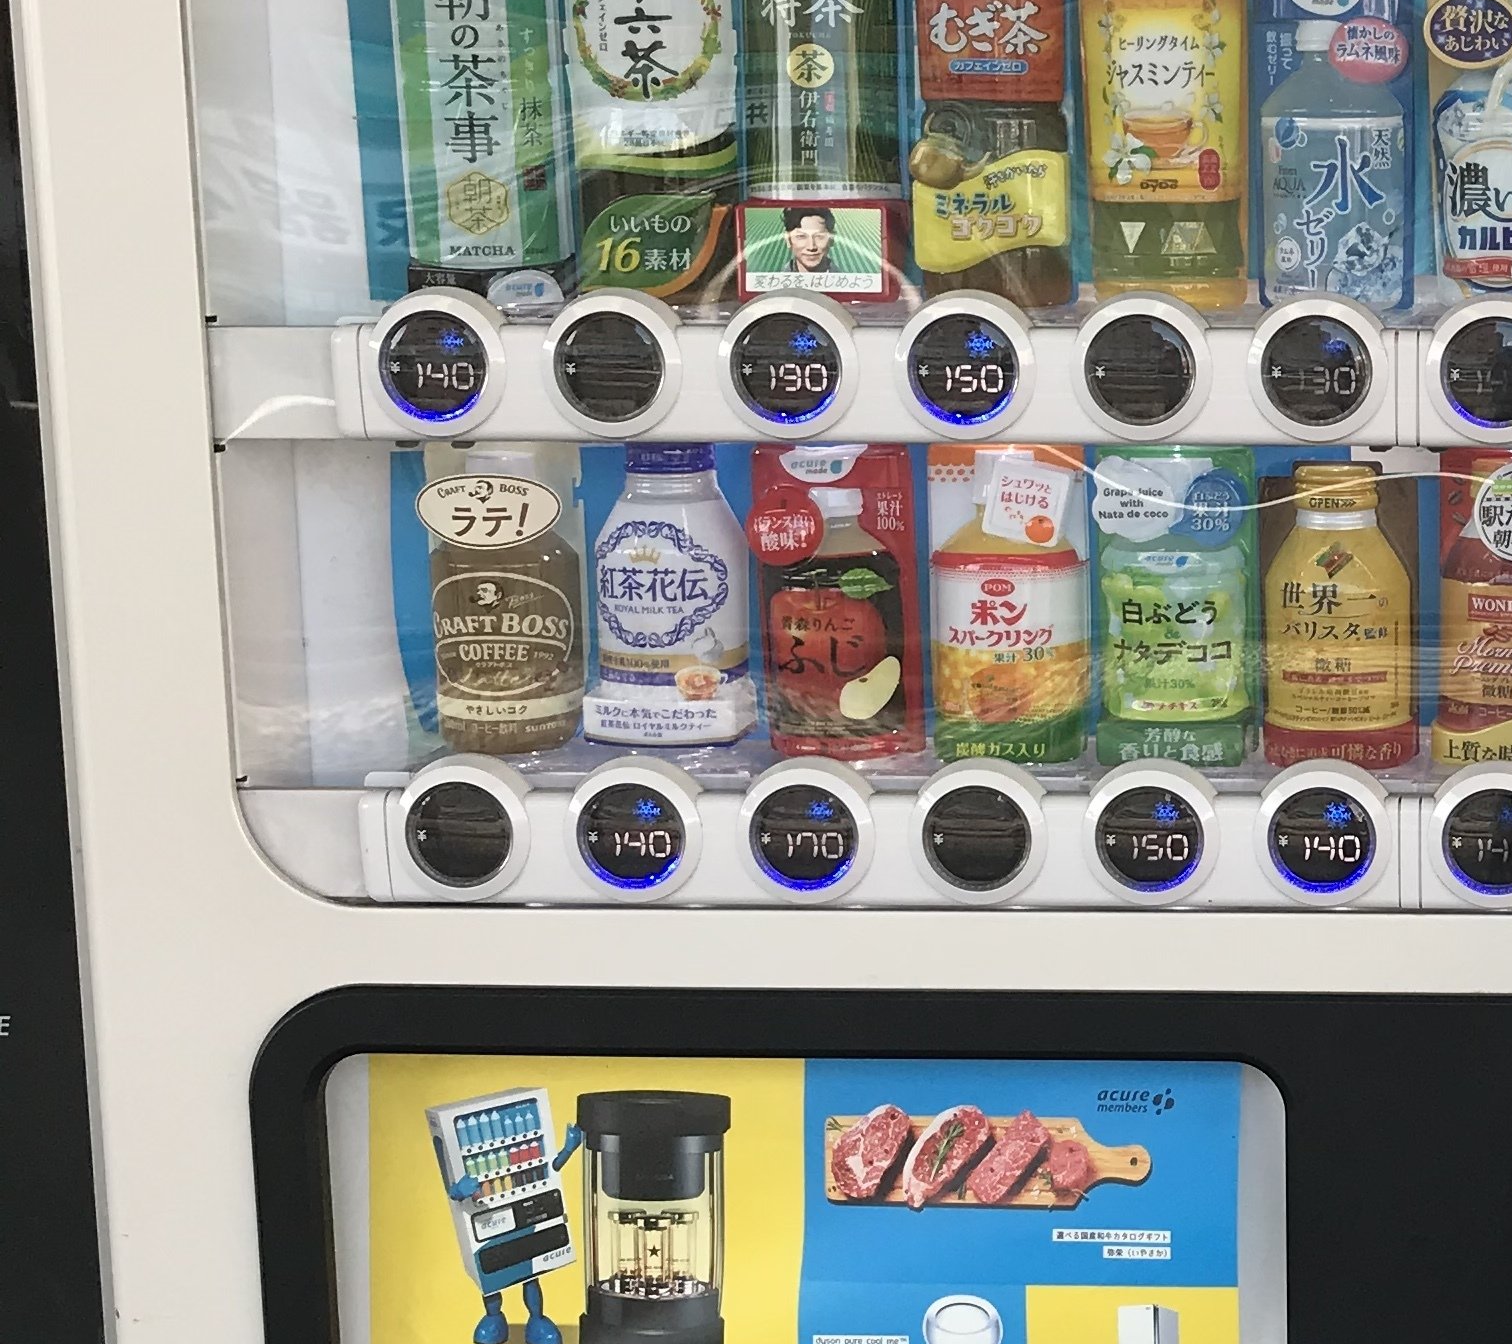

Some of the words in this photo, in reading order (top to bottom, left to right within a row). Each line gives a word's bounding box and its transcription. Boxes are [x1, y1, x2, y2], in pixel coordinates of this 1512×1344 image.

[928, 0, 1050, 56] むぎ茶
[792, 49, 829, 83] 茶
[607, 212, 693, 236] いいもの
[595, 235, 693, 273] 16素材
[415, 361, 476, 391] 140
[945, 364, 1006, 395] 150
[451, 502, 530, 538] ラテ!
[1098, 510, 1125, 519] Nata
[1127, 509, 1141, 518] de
[1144, 510, 1169, 519] coco
[1190, 518, 1231, 532] 30%
[600, 566, 710, 603] 紅茶花伝
[433, 611, 498, 639] CRAFT
[501, 611, 569, 639] BOSS
[781, 615, 856, 633] 青森りんご
[970, 599, 1028, 626] ポン
[1121, 599, 1218, 626] 白ぶどう
[949, 624, 1053, 647] スパークリング
[458, 643, 530, 662] COFFEE
[778, 634, 866, 678] ふじ
[1112, 638, 1232, 665] ナタデココ
[614, 829, 672, 859] 140
[1132, 833, 1190, 862] 150
[1303, 834, 1362, 863] 140
[1096, 1102, 1148, 1114] members
[1097, 1088, 1150, 1102] acure
